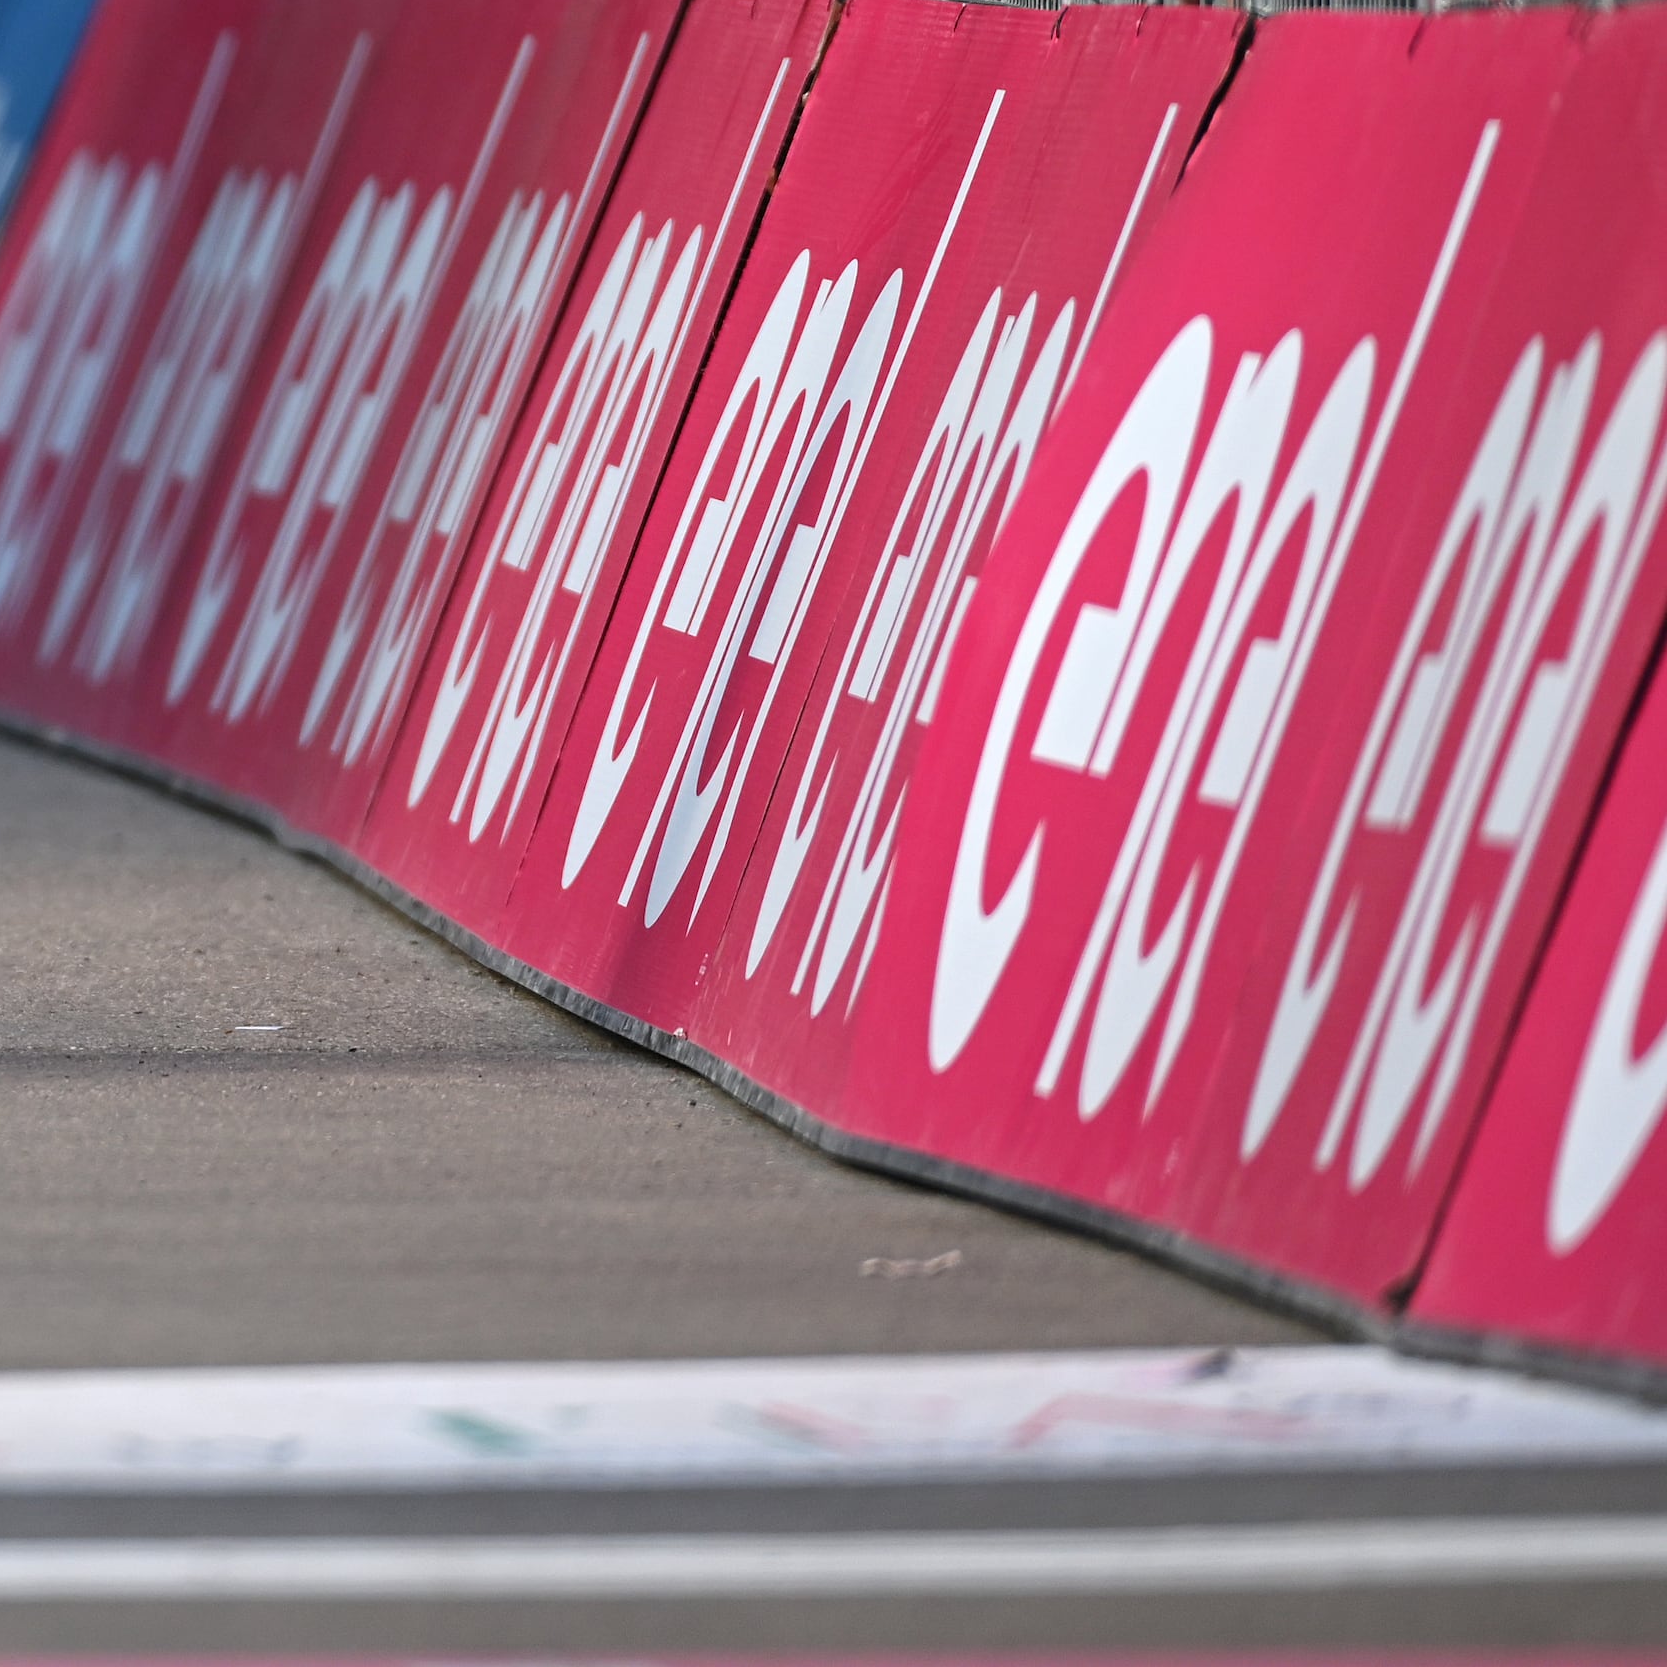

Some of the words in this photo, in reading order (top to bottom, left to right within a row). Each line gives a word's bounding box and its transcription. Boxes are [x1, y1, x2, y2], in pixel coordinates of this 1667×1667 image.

[165, 34, 539, 725] enel
[299, 32, 651, 769] enel
[407, 56, 791, 848] enel
[561, 89, 1006, 937] enel
[928, 119, 1502, 1126] enel
